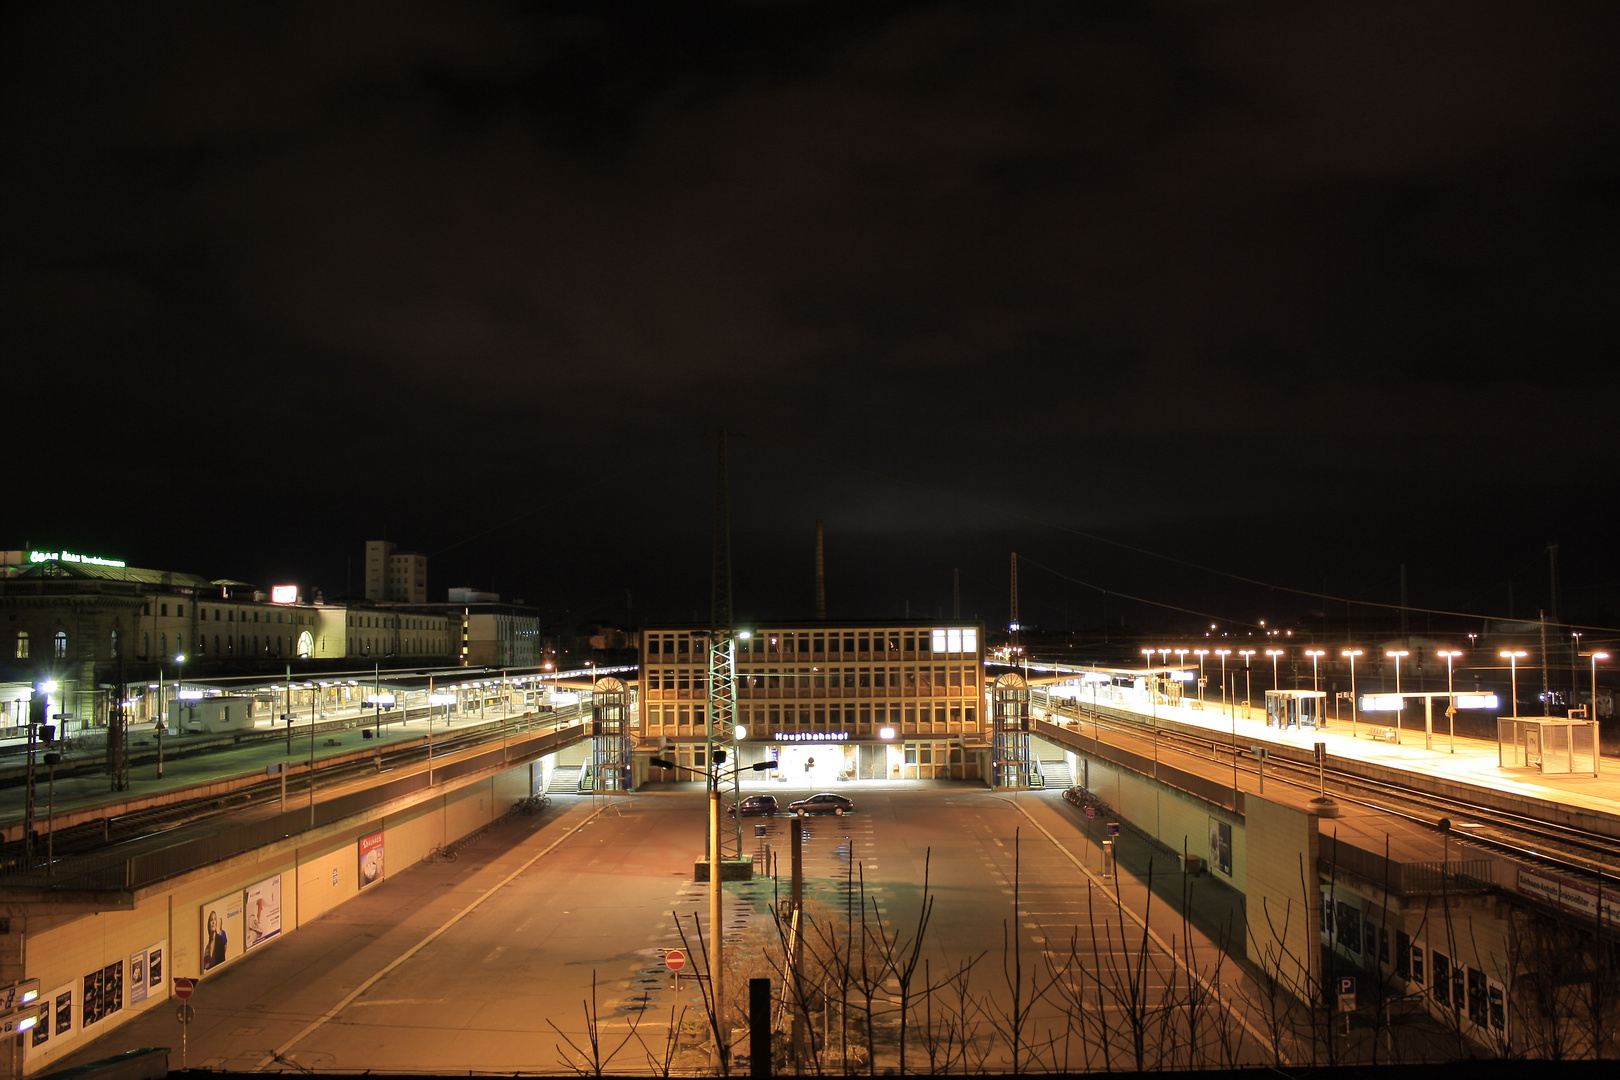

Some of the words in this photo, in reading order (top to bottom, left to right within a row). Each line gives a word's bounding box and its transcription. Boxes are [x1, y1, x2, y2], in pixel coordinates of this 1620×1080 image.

[775, 732, 848, 741] Hauptbahnhof
[364, 836, 381, 848] BAUHAUS
[1341, 979, 1352, 993] P
